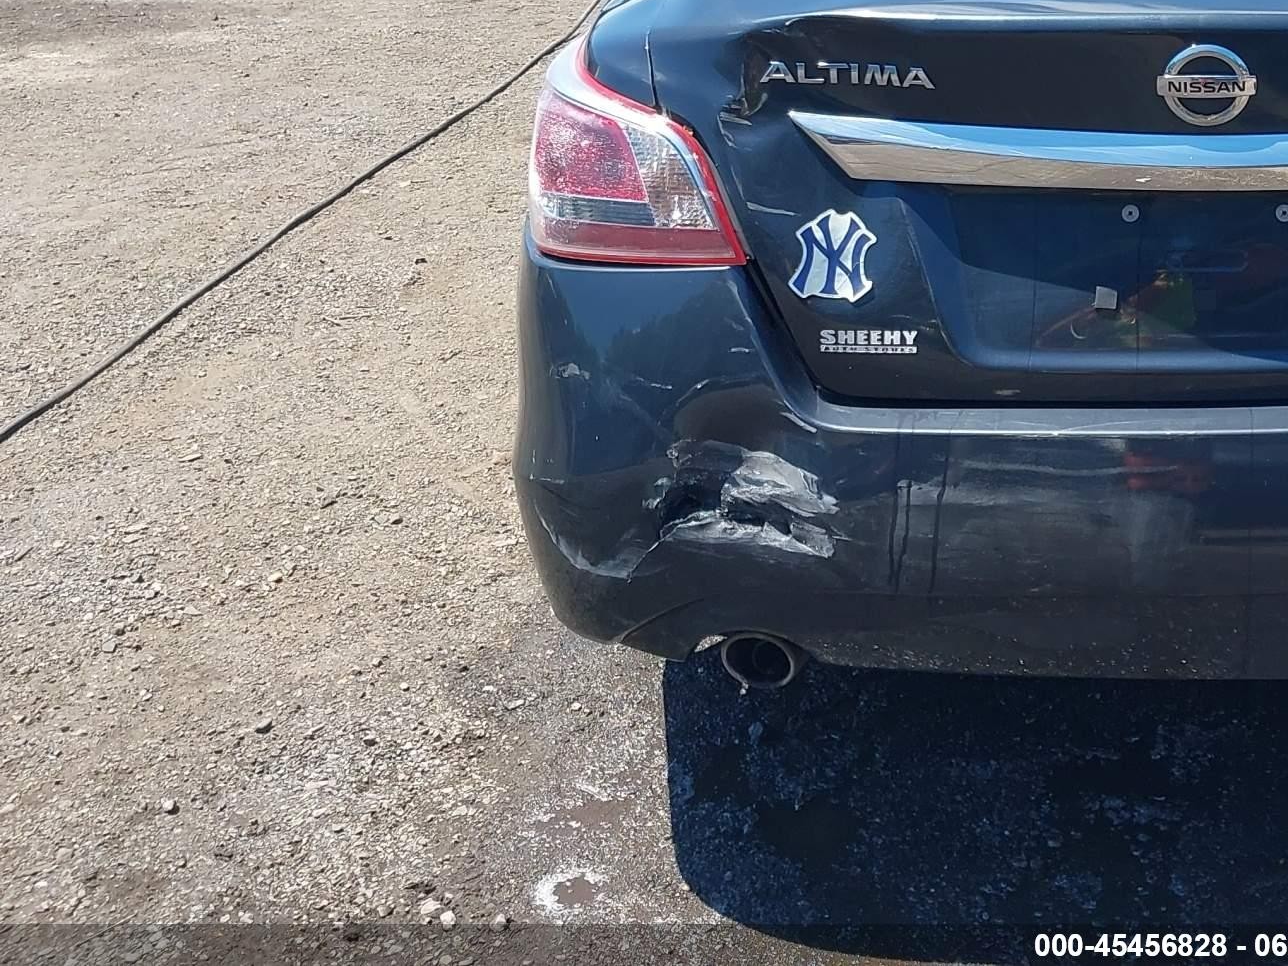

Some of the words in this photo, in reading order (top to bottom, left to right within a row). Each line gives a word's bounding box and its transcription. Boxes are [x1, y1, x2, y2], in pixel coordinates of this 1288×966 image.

[759, 60, 936, 90] ALTIMA
[1167, 81, 1246, 93] NISSAN
[820, 330, 918, 345] SHEEHY
